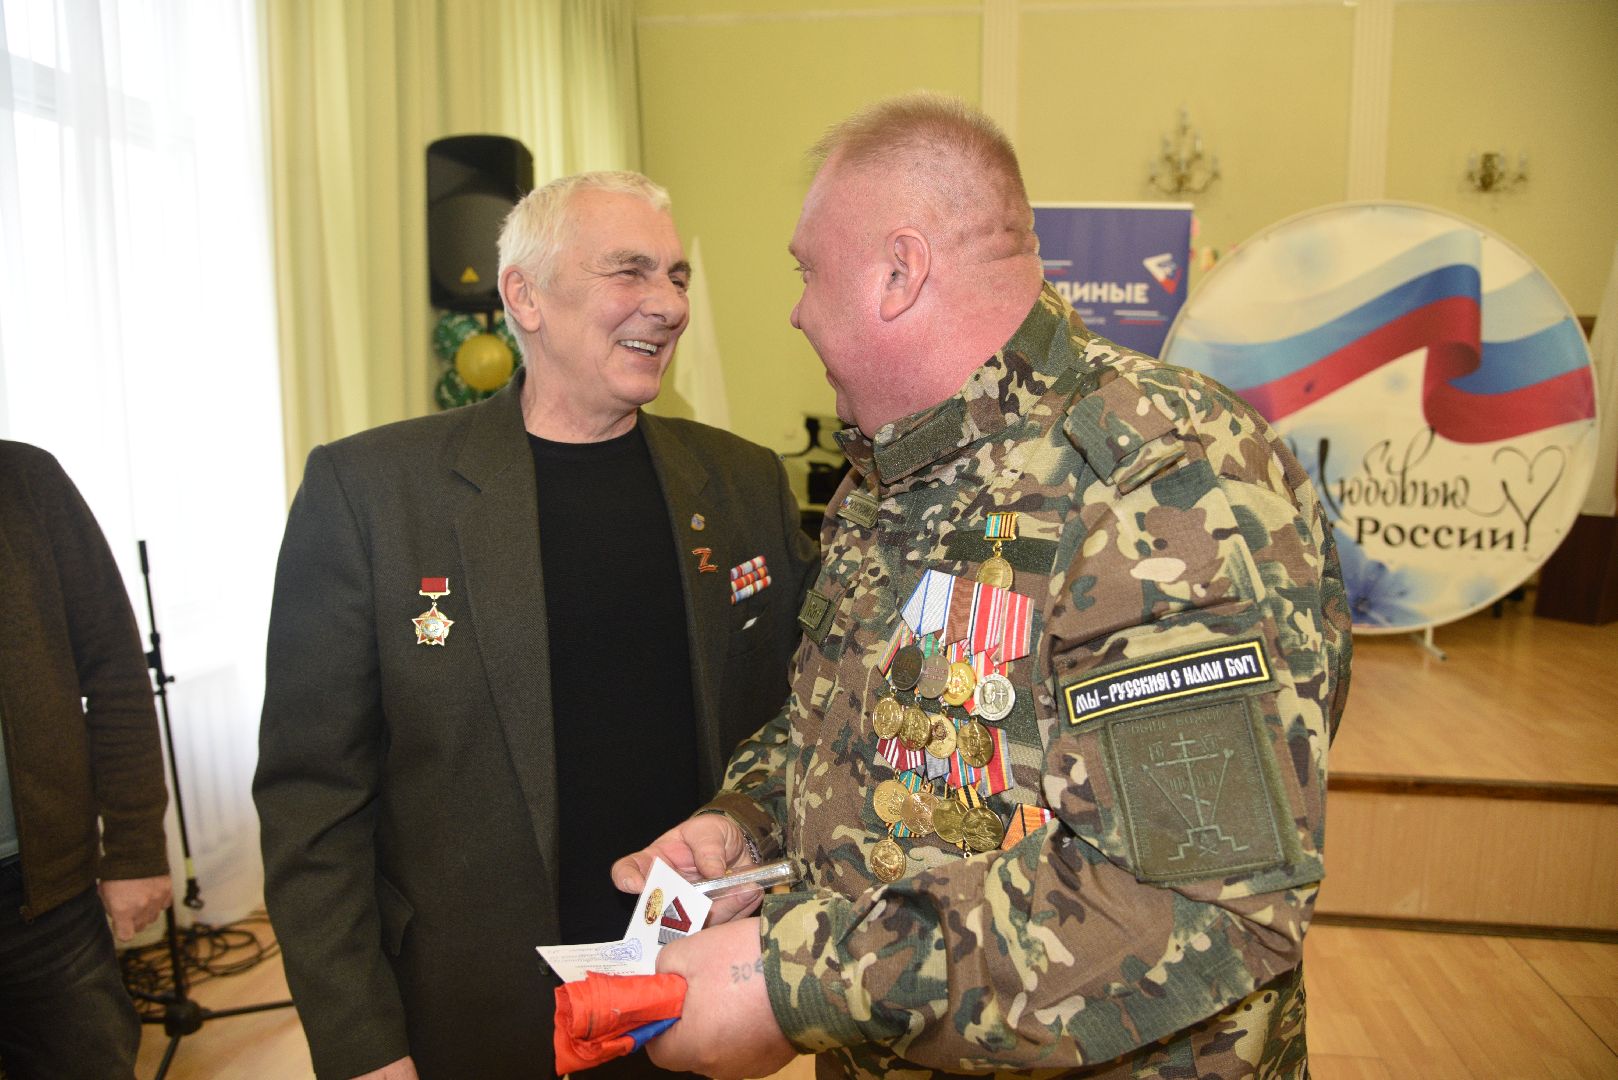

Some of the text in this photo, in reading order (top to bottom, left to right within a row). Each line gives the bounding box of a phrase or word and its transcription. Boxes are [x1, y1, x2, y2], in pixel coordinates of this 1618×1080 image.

[1054, 281, 1149, 304] ДИНЫЕ
[1076, 689, 1101, 714] МЫ
[1170, 669, 1181, 688] С
[1182, 660, 1224, 686] НАМИ
